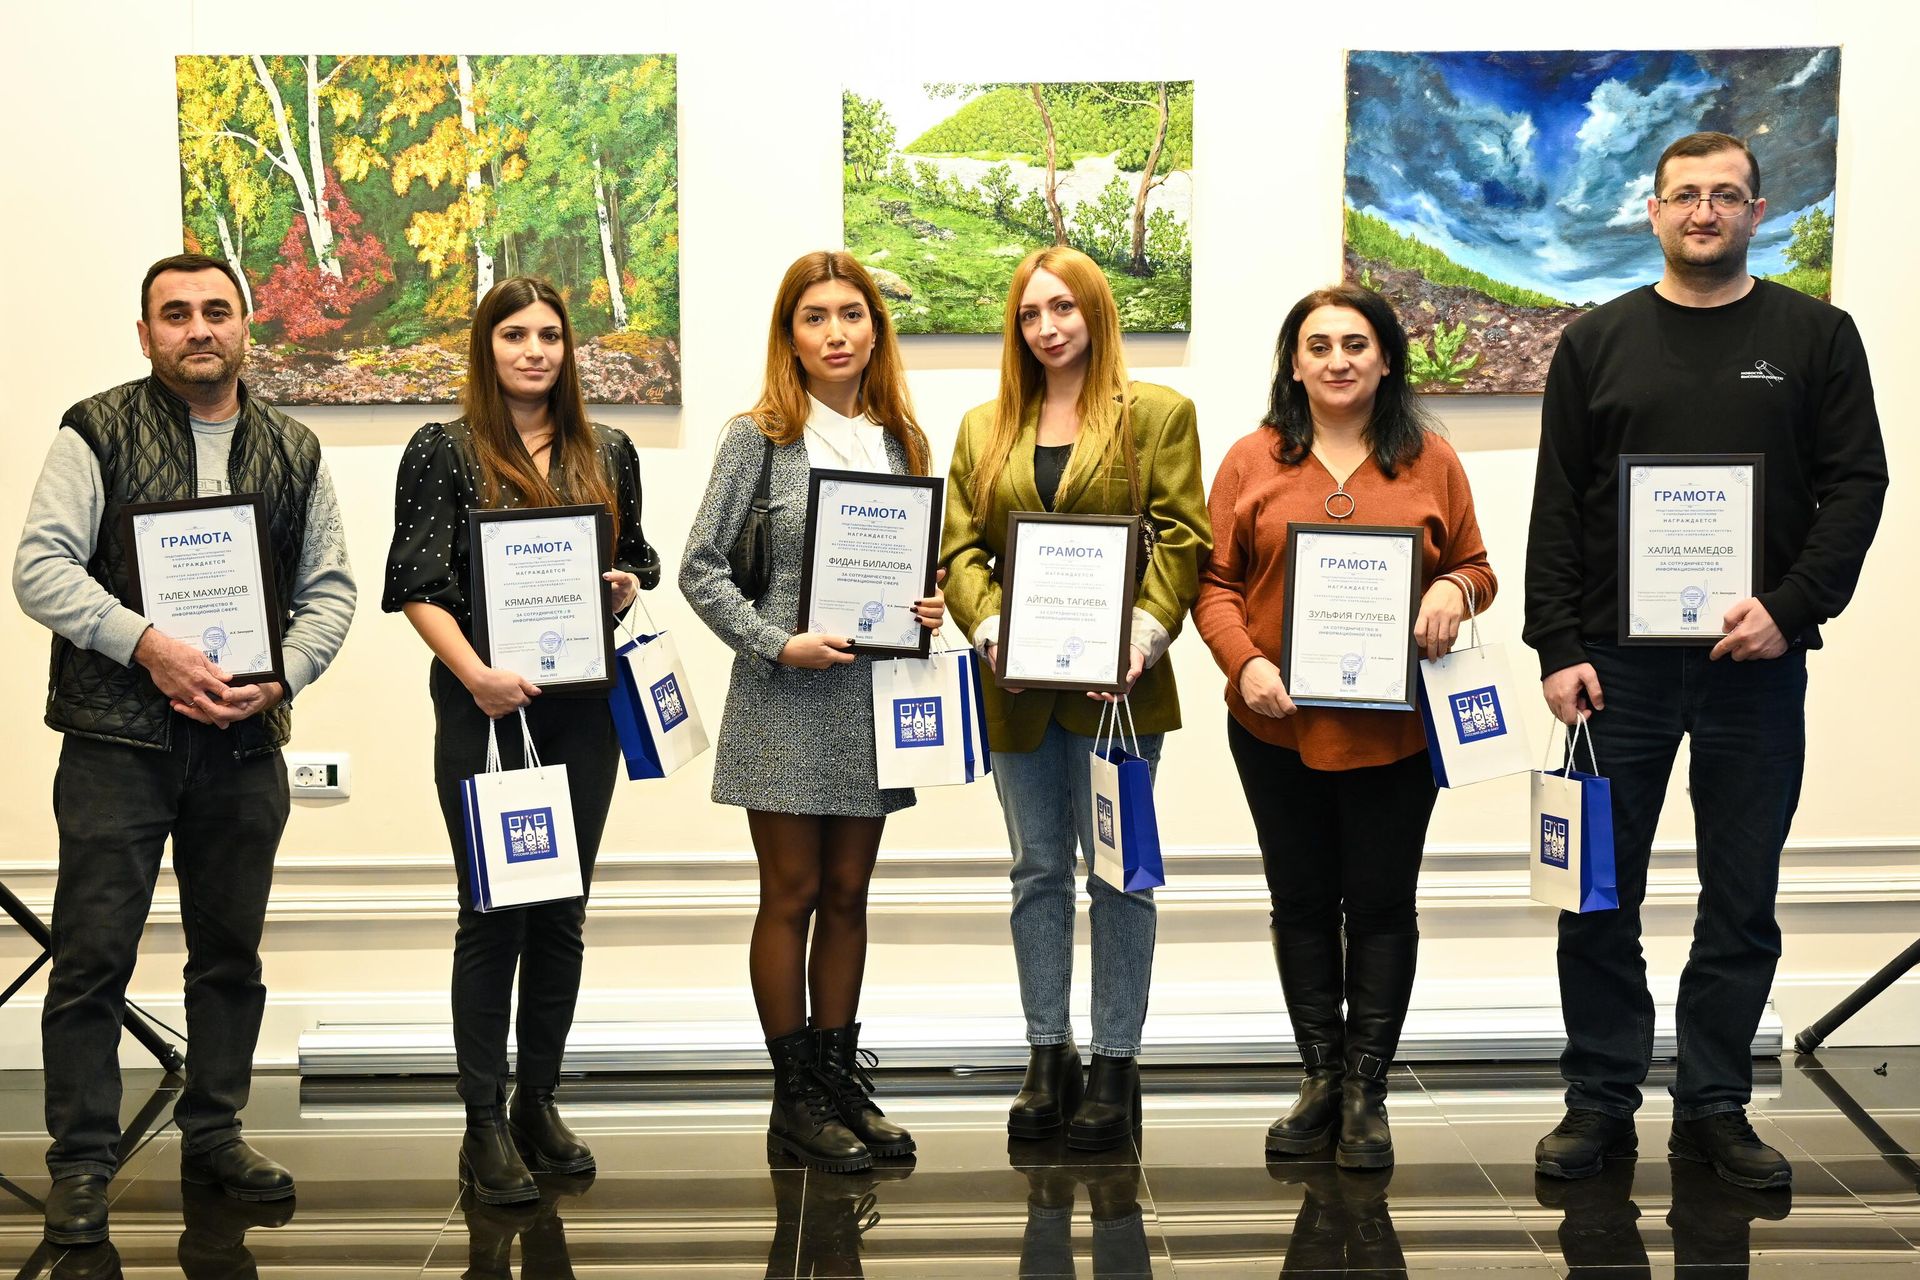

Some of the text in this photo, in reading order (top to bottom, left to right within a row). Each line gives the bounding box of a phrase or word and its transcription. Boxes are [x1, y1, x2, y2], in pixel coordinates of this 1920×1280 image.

[1654, 491, 1726, 502] ГРАМОТА
[841, 505, 907, 520] ГРАМОТА
[161, 531, 232, 548] ГРАМОТА
[506, 541, 572, 556] ГРАМОТА
[1039, 546, 1103, 558] ГРАМОТА
[1648, 546, 1733, 555] ХАЛИД МАМЕДОВ
[173, 560, 226, 569] НАГРАЖДАЕТСЯ
[828, 557, 912, 570] ФИДАН БИЛАЛОВА
[1320, 558, 1387, 571] ГРАМОТА
[159, 585, 248, 601] ТАЛЕХ МАХМУДОВ
[505, 594, 582, 607] КЯМАЛЯ АЛИЕВА
[1027, 595, 1107, 607] АЙГЮЛЬ ТАГИЕВА
[183, 603, 228, 611] СОТРУДНИЧЕСТВО
[1309, 610, 1396, 622] ЗУЛЬФИЯ ГУЛУЕВА
